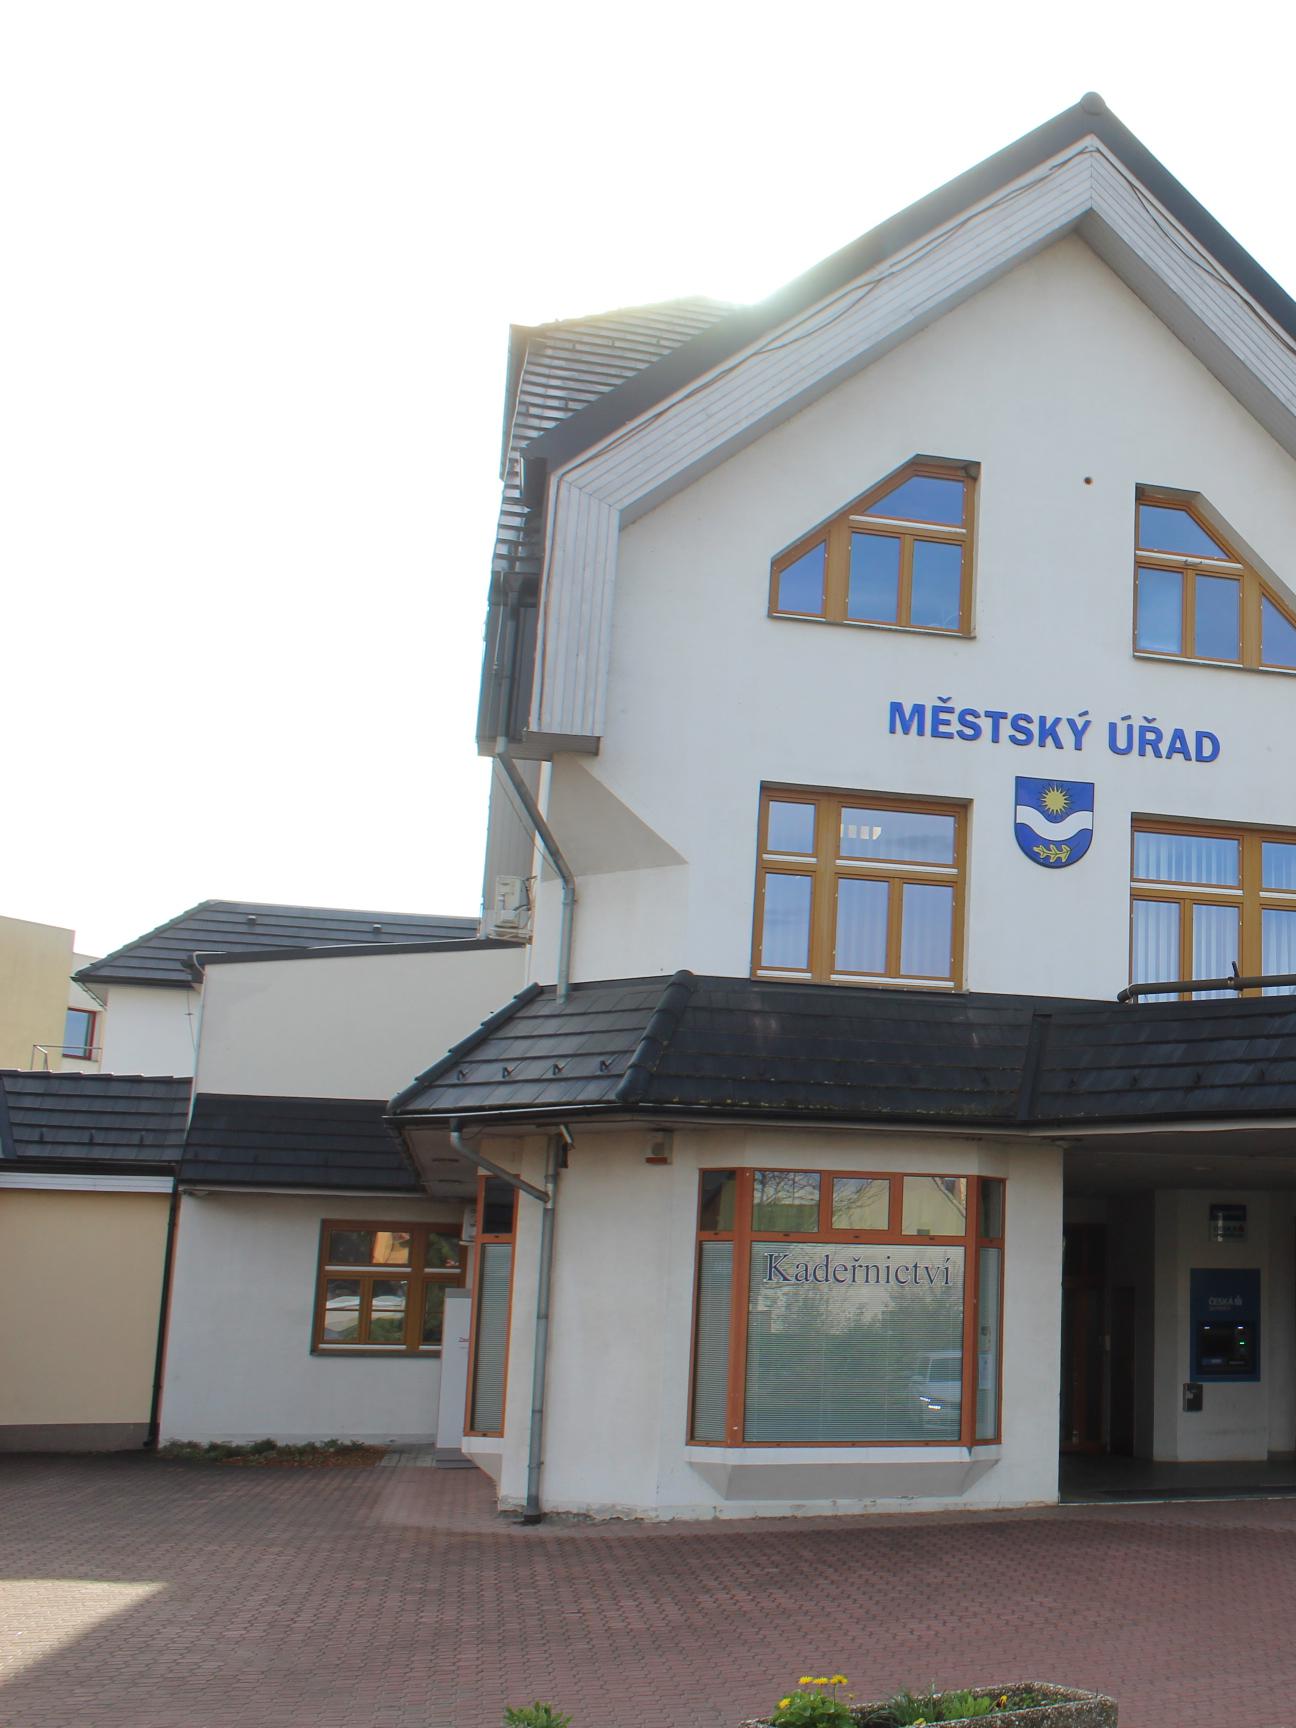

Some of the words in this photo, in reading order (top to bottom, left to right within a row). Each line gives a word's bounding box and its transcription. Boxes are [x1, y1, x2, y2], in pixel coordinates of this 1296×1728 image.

[888, 696, 1092, 751] MĚSTSKÝ
[1108, 714, 1222, 763] ÚŘAD
[763, 1252, 952, 1286] Kadeřnictví
